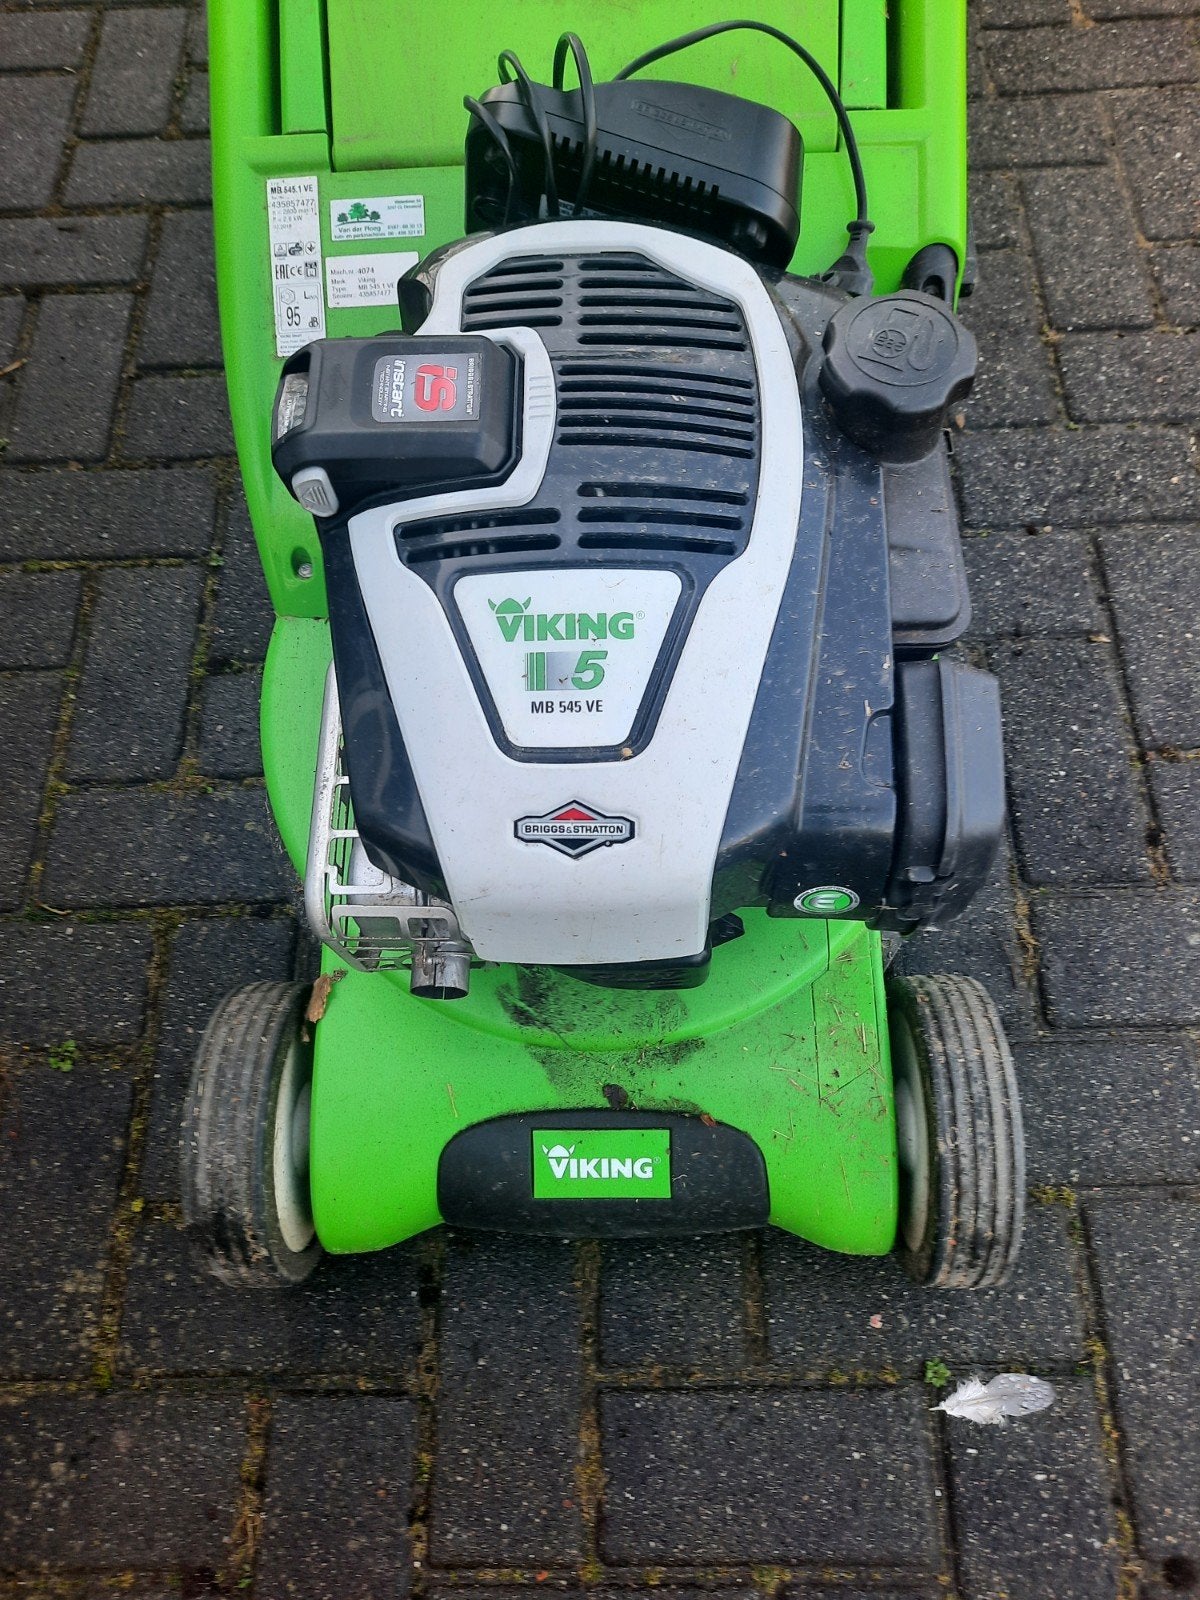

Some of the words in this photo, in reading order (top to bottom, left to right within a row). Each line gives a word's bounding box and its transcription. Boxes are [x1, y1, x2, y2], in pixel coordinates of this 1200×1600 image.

[303, 184, 314, 192] VE
[271, 199, 315, 209] 435857477
[357, 266, 375, 275] 4074
[286, 306, 301, 327] 95
[390, 359, 406, 418] instart
[496, 611, 635, 642] VIKING
[570, 650, 609, 690] 5
[530, 701, 554, 714] MB
[559, 700, 582, 713] 545
[585, 700, 604, 713] VE
[548, 1157, 653, 1179] VIKING
